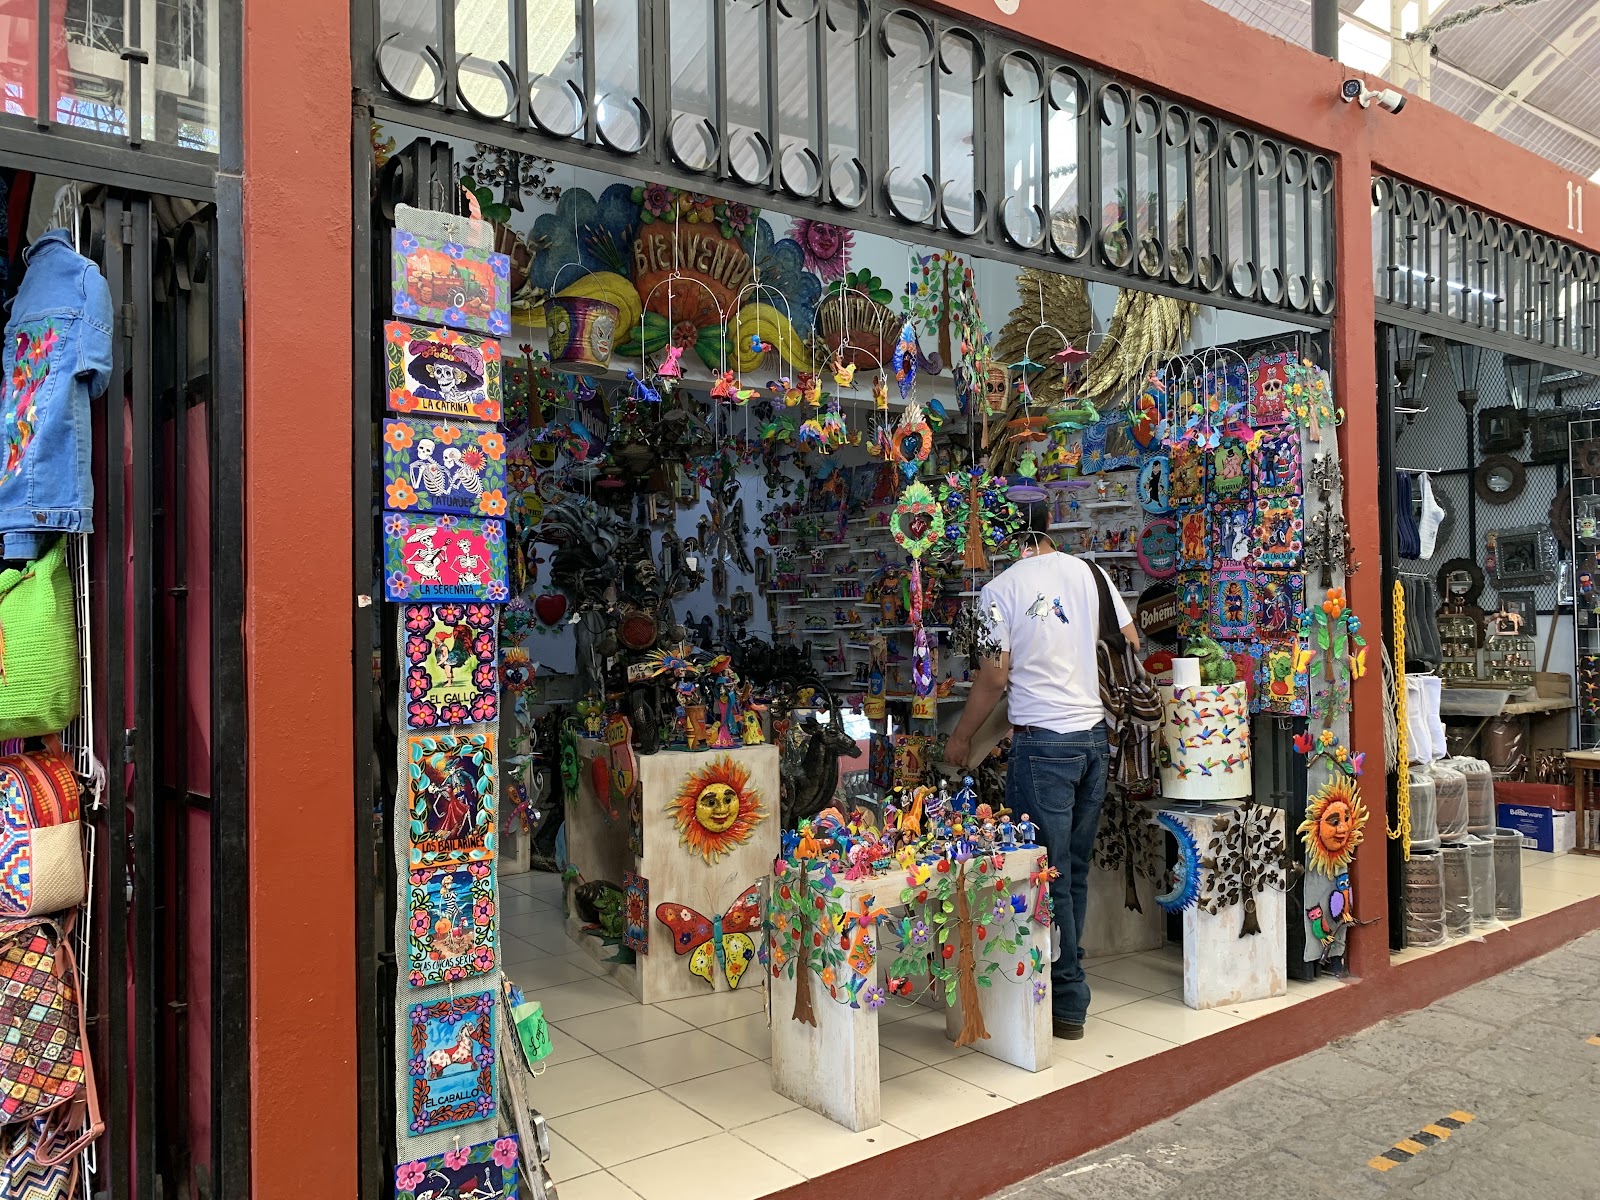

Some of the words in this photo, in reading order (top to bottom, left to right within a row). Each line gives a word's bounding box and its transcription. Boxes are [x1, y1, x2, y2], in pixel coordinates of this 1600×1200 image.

[1566, 180, 1584, 234] 11
[422, 399, 434, 410] LA
[435, 400, 469, 414] CATRINA
[419, 585, 431, 595] LA
[433, 584, 474, 596] SERENATA
[1140, 601, 1177, 629] Bohemi
[429, 694, 442, 705] EL
[443, 691, 477, 703] GALLO
[421, 841, 437, 853] LOS
[438, 836, 485, 852] BAILARINES
[455, 953, 476, 966] SEXIS
[425, 1098, 436, 1109] EL
[437, 1088, 480, 1105] CABALLO
